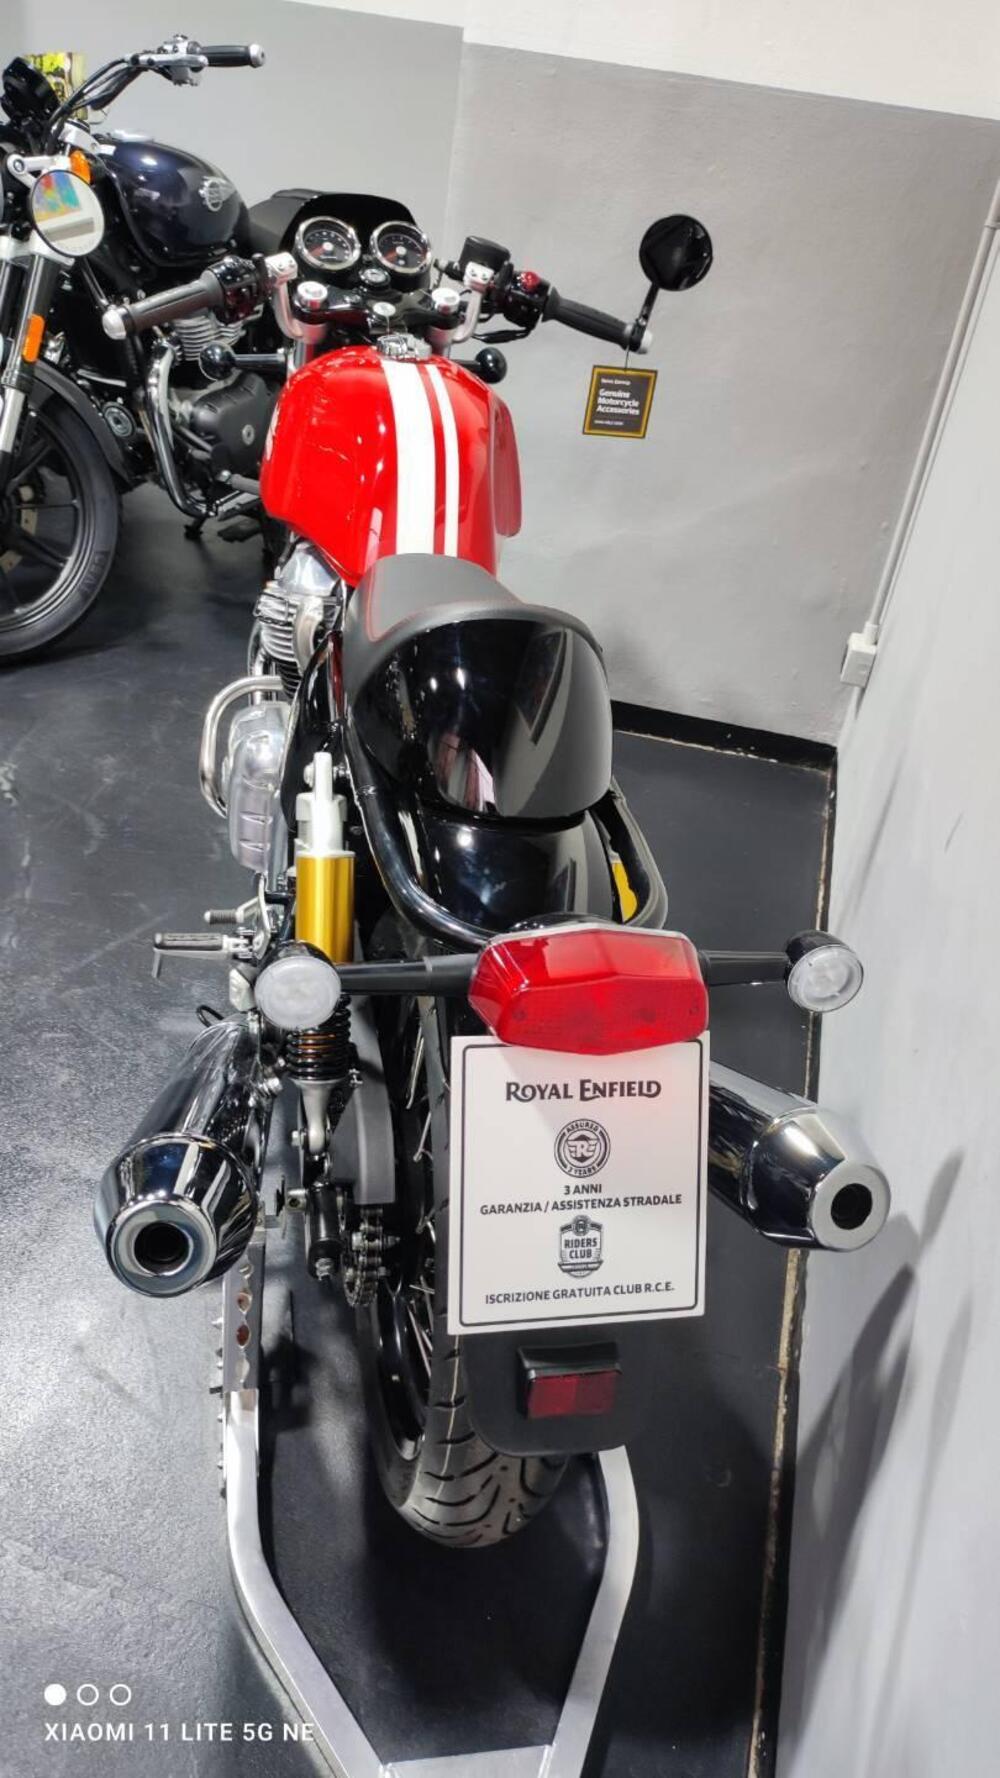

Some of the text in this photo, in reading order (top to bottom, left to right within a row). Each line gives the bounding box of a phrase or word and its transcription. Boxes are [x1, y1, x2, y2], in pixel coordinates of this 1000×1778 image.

[599, 388, 630, 398] Genuine
[597, 397, 639, 407] Motorcycle
[596, 405, 640, 415] Accessories
[564, 1184, 602, 1195] 3 ANNI
[480, 1194, 682, 1215] GARANZIA / ASSISTENZA STRADALE
[564, 1237, 598, 1249] RIDERS
[569, 1249, 593, 1259] CLUB
[485, 1281, 675, 1304] ISCRIZIONE GRATUITA CLUB R.C.E.
